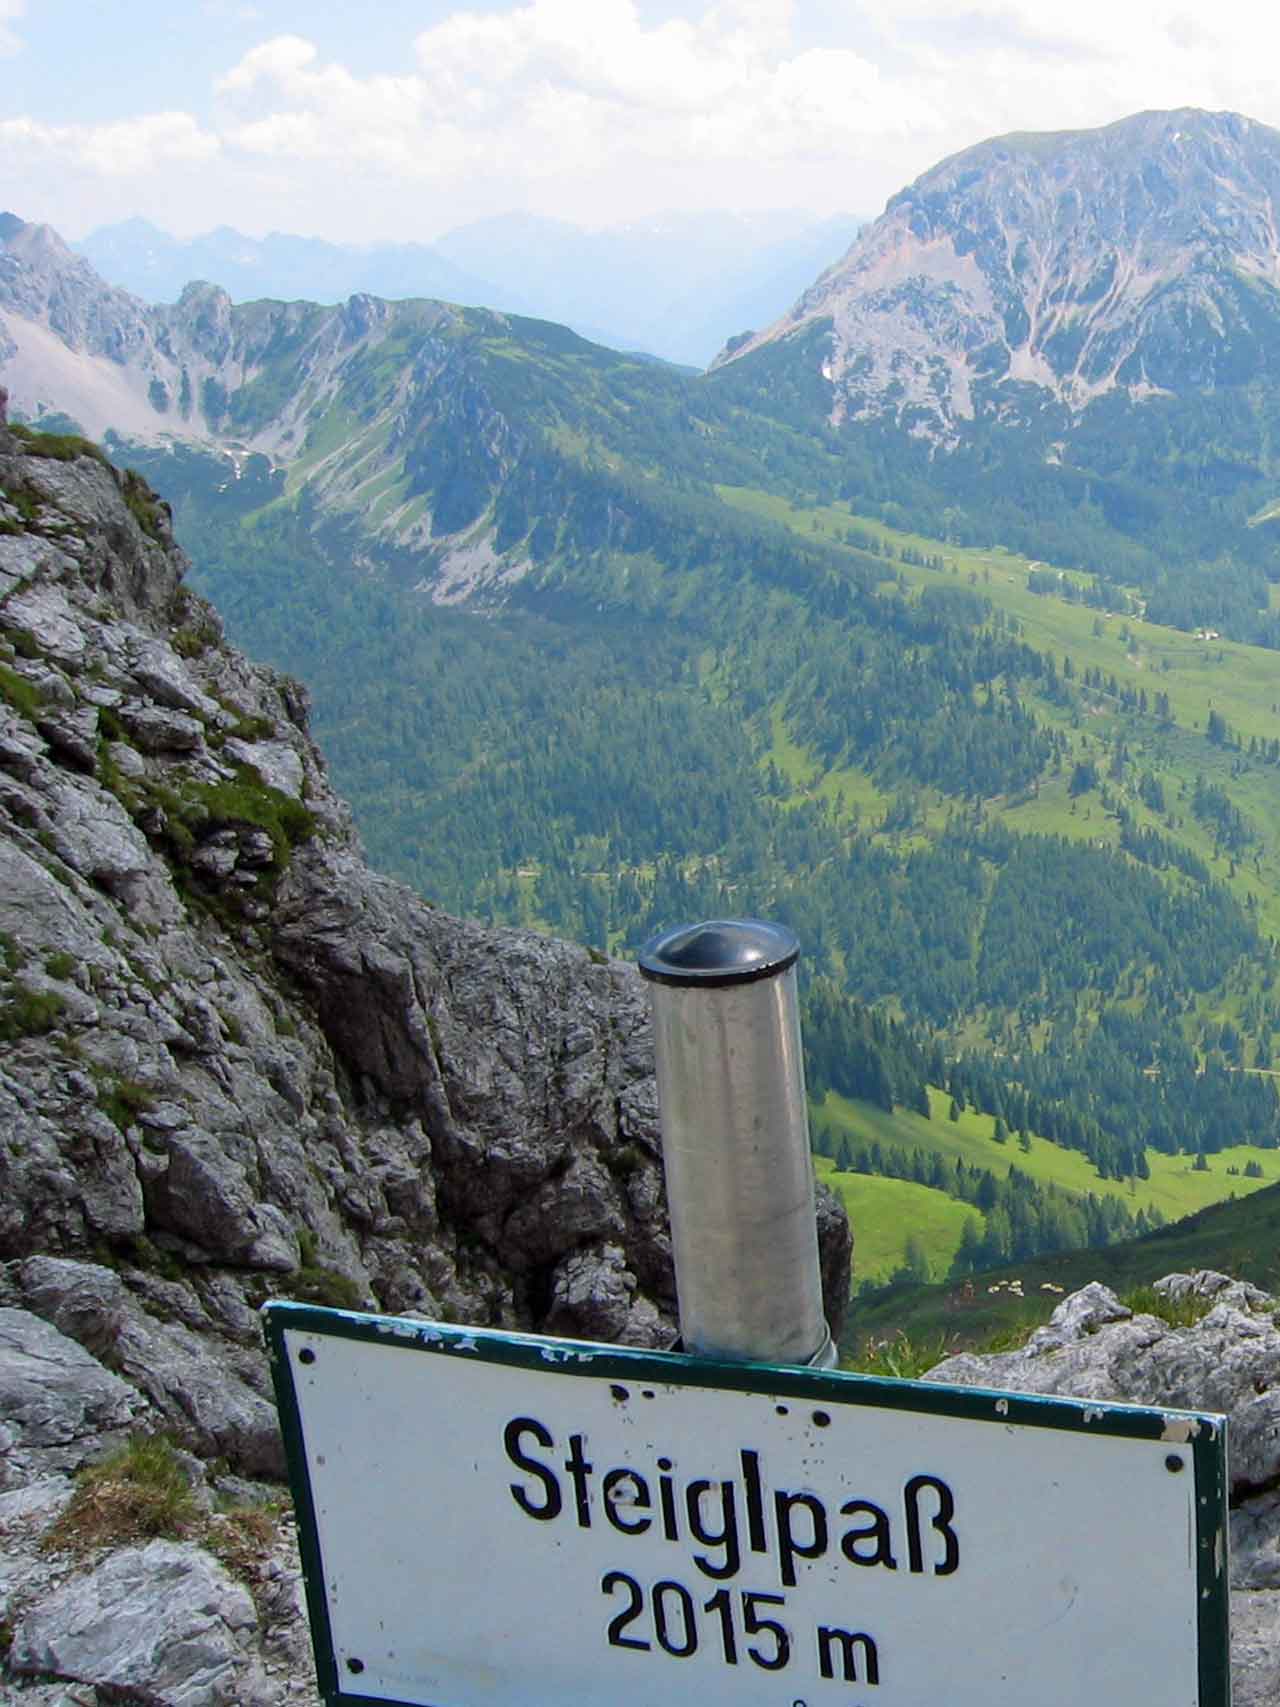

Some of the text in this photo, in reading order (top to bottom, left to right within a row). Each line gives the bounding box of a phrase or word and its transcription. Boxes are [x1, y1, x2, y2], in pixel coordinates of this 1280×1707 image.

[502, 1415, 961, 1588] Steiglpaß
[600, 1569, 881, 1687] 2015 m
